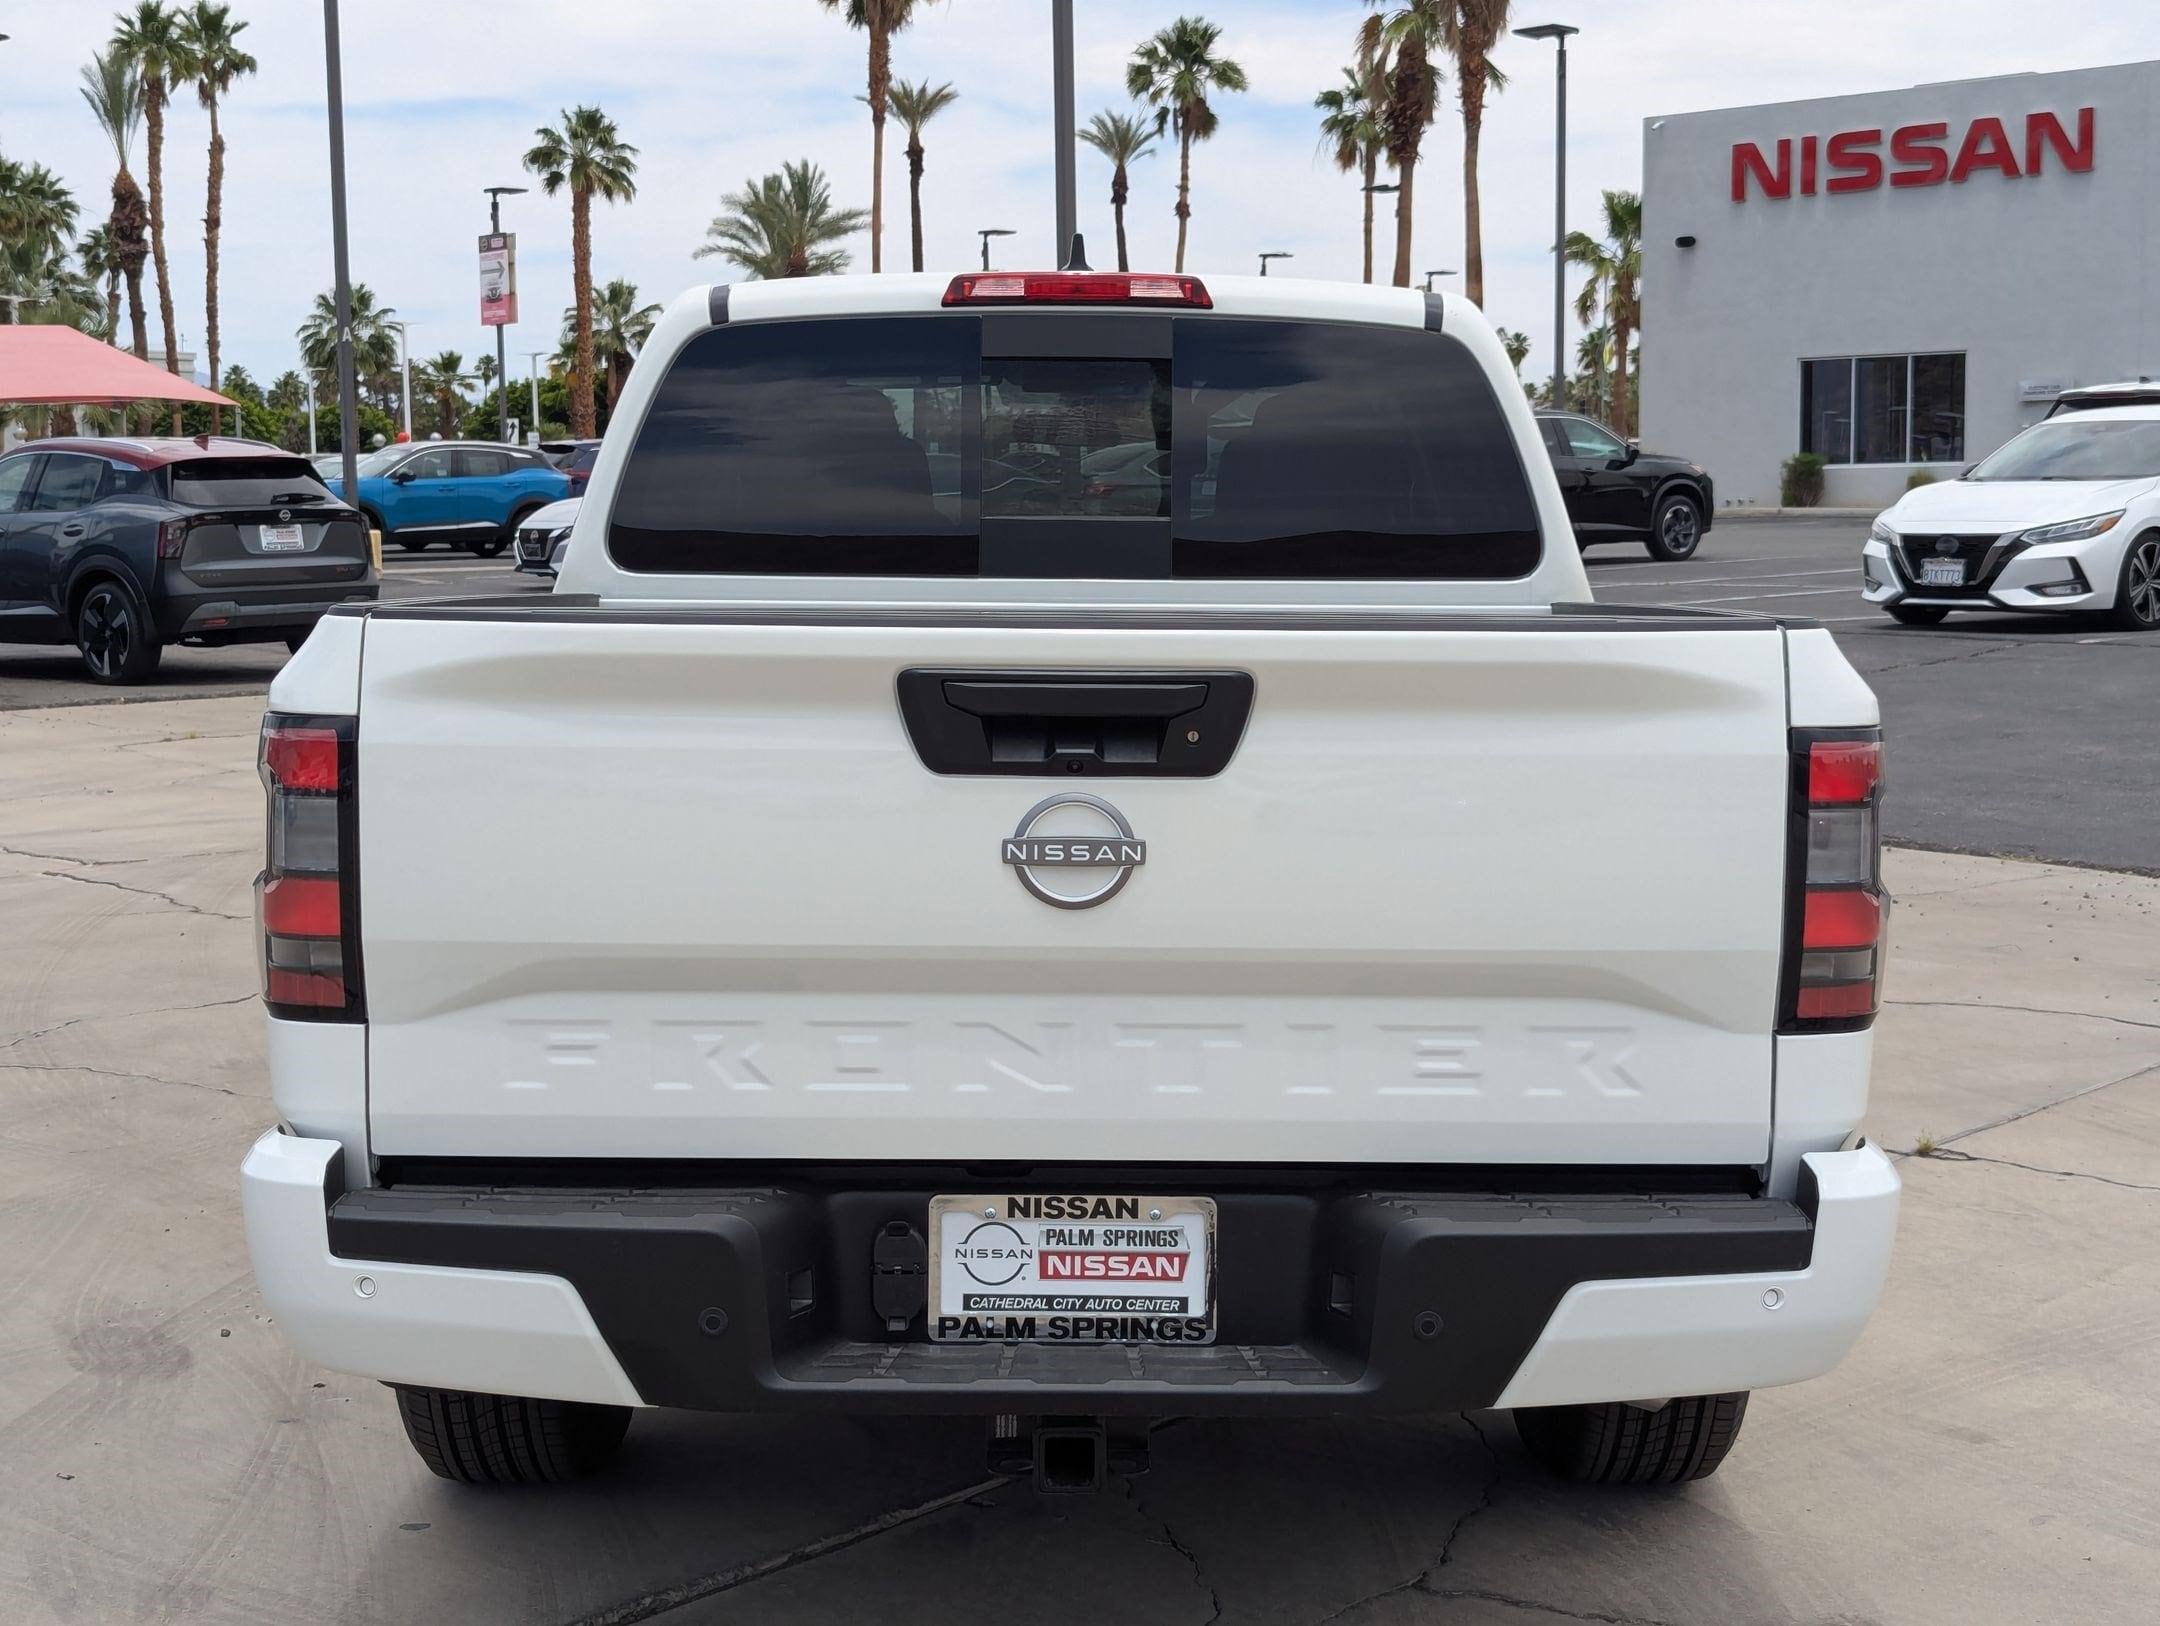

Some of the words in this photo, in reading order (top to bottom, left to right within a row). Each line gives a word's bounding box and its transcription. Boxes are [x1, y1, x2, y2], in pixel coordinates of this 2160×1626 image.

[1731, 107, 2095, 202] NISSAN
[342, 326, 352, 342] A
[1006, 843, 1142, 862] NISSAN
[503, 1018, 1644, 1097] FRONTIER
[1007, 1197, 1139, 1219] NISSAN
[1046, 1229, 1095, 1246] PALM
[1103, 1229, 1179, 1247] SPRINGS
[955, 1248, 1033, 1259] NISSAN
[1047, 1255, 1180, 1278] NISSAN
[970, 1297, 1049, 1310] CATHEDRAL
[1053, 1298, 1083, 1311] CITY
[1085, 1299, 1124, 1311] AUTO
[1128, 1299, 1180, 1311] CENTER
[938, 1316, 1037, 1339] PALM
[1047, 1316, 1207, 1341] SPRINGS
